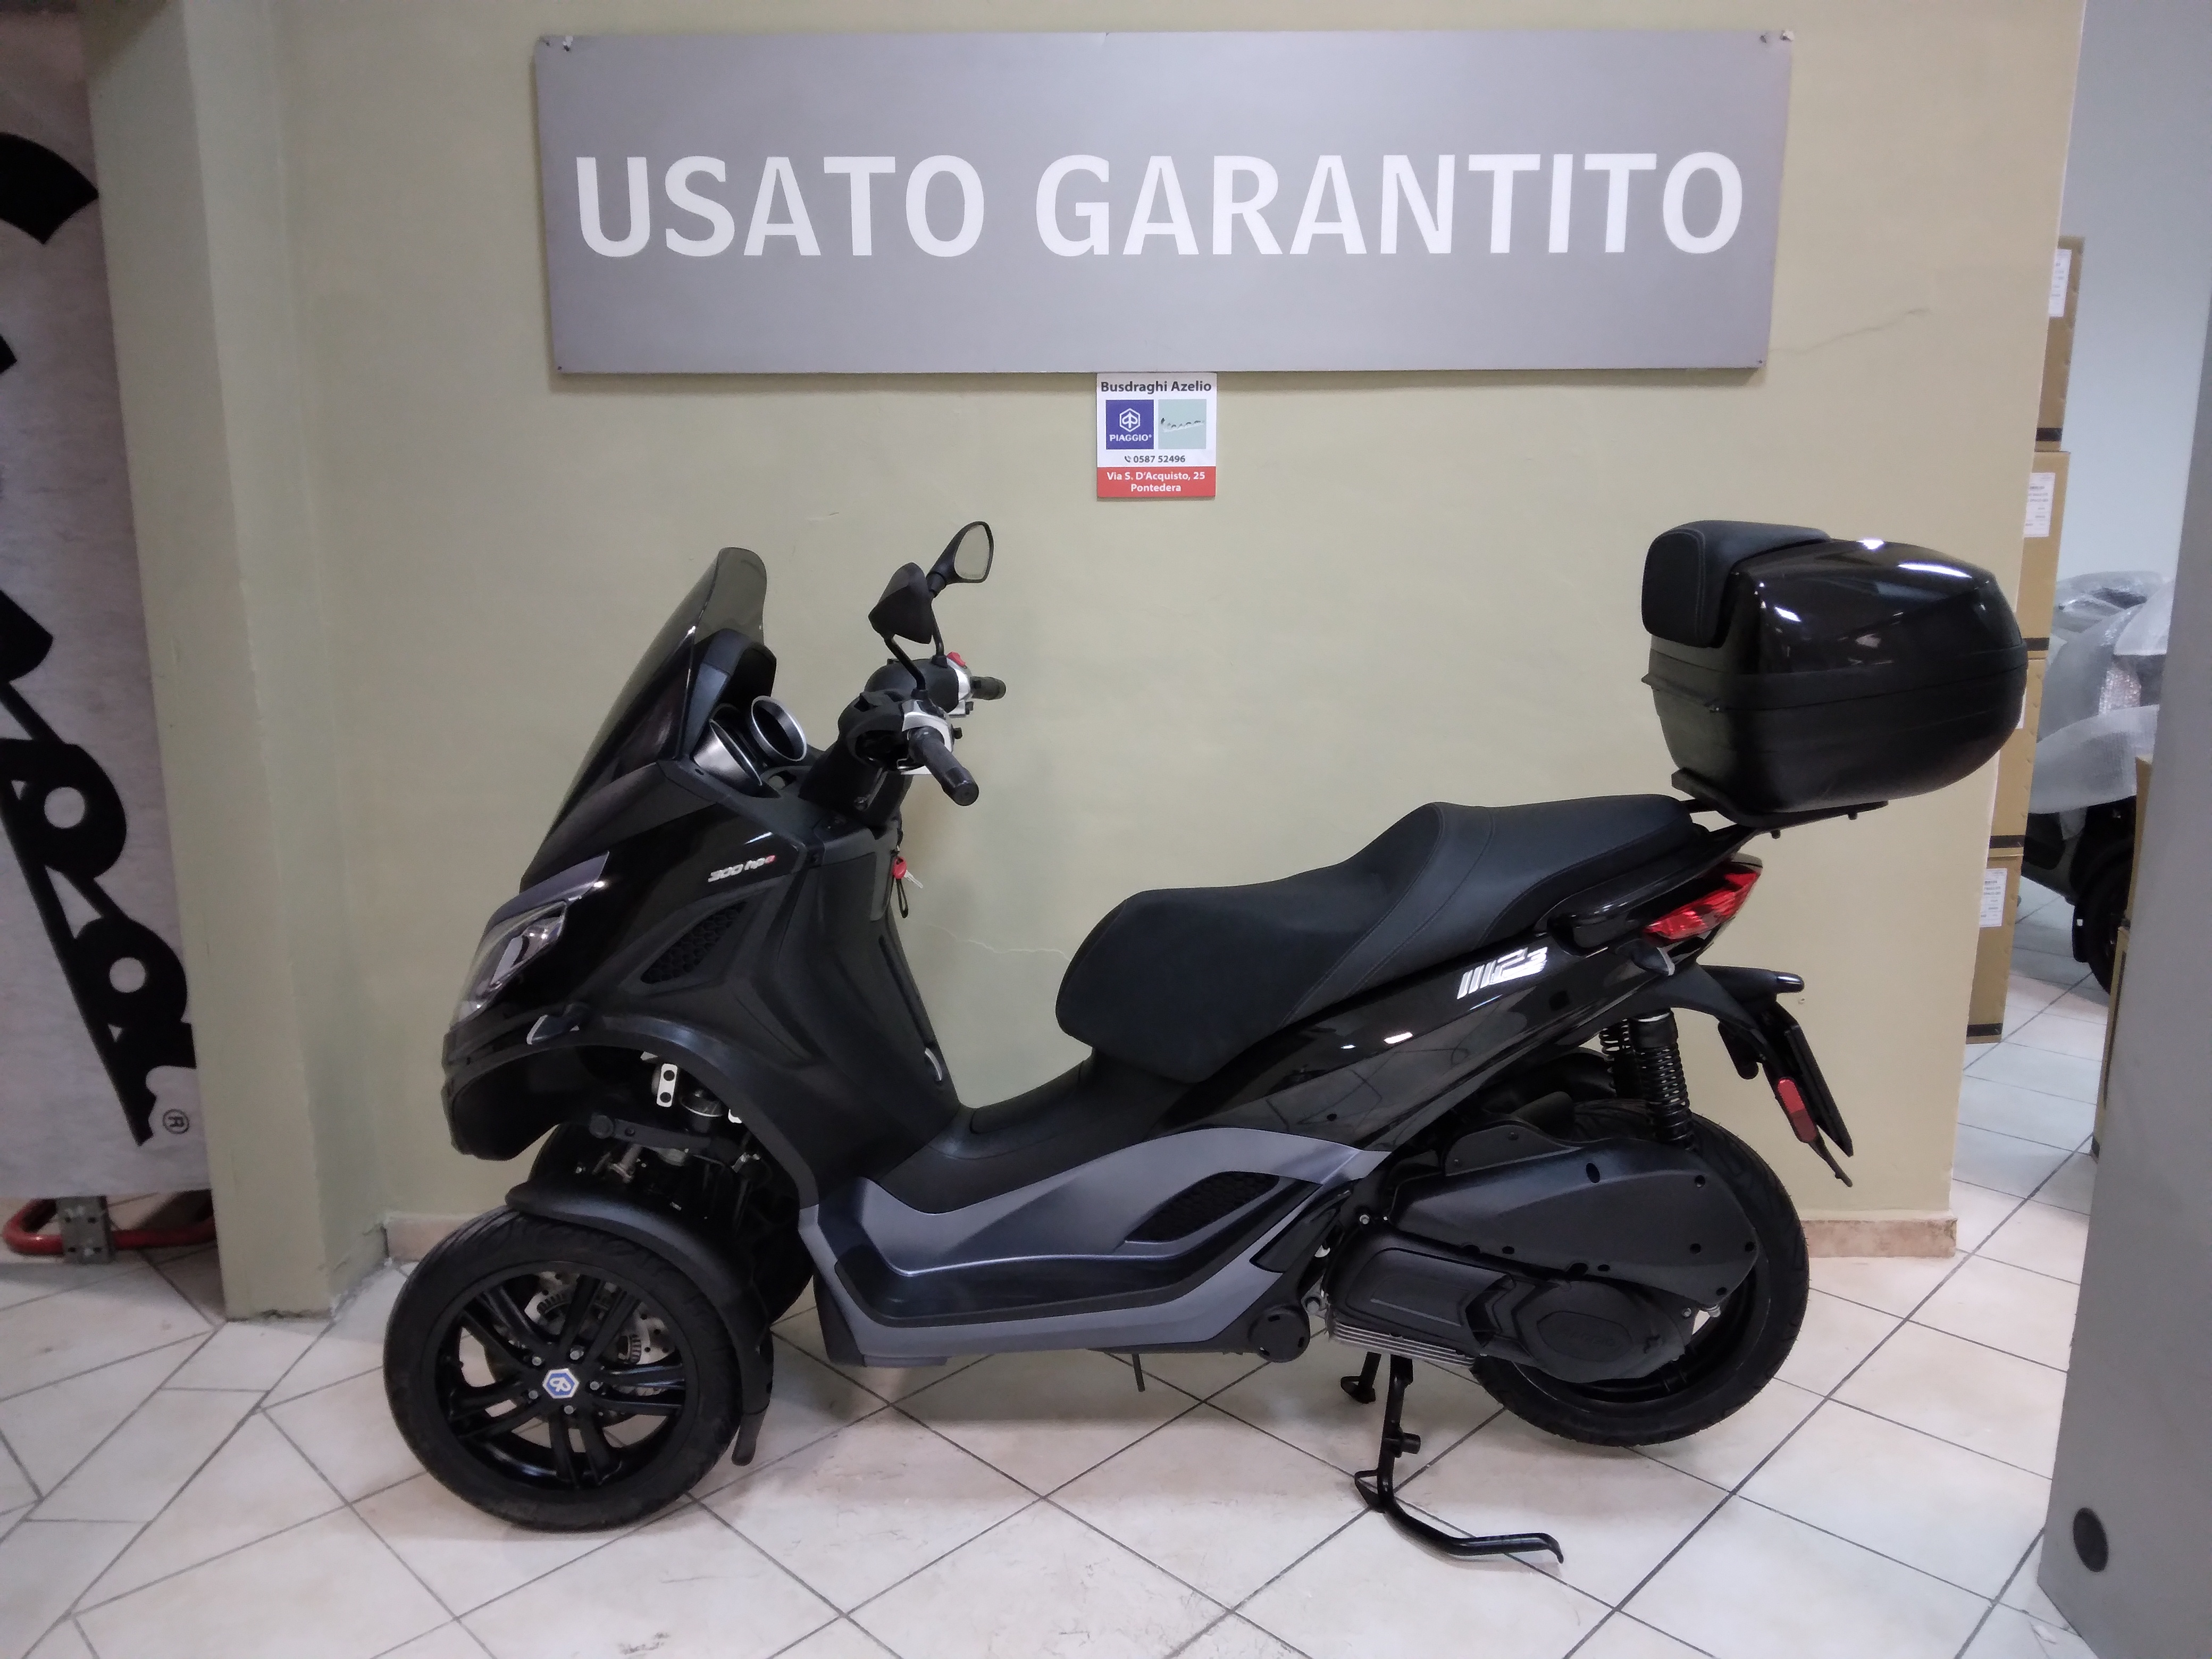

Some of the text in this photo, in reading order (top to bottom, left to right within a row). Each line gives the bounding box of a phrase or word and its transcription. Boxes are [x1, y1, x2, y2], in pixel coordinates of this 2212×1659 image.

[576, 152, 1743, 258] USATO GARANTITO
[1101, 380, 1212, 395] Busdraghi Azelio
[1107, 471, 1205, 482] Via S. D'Acquisto, 25
[1130, 483, 1182, 492] Pontedera
